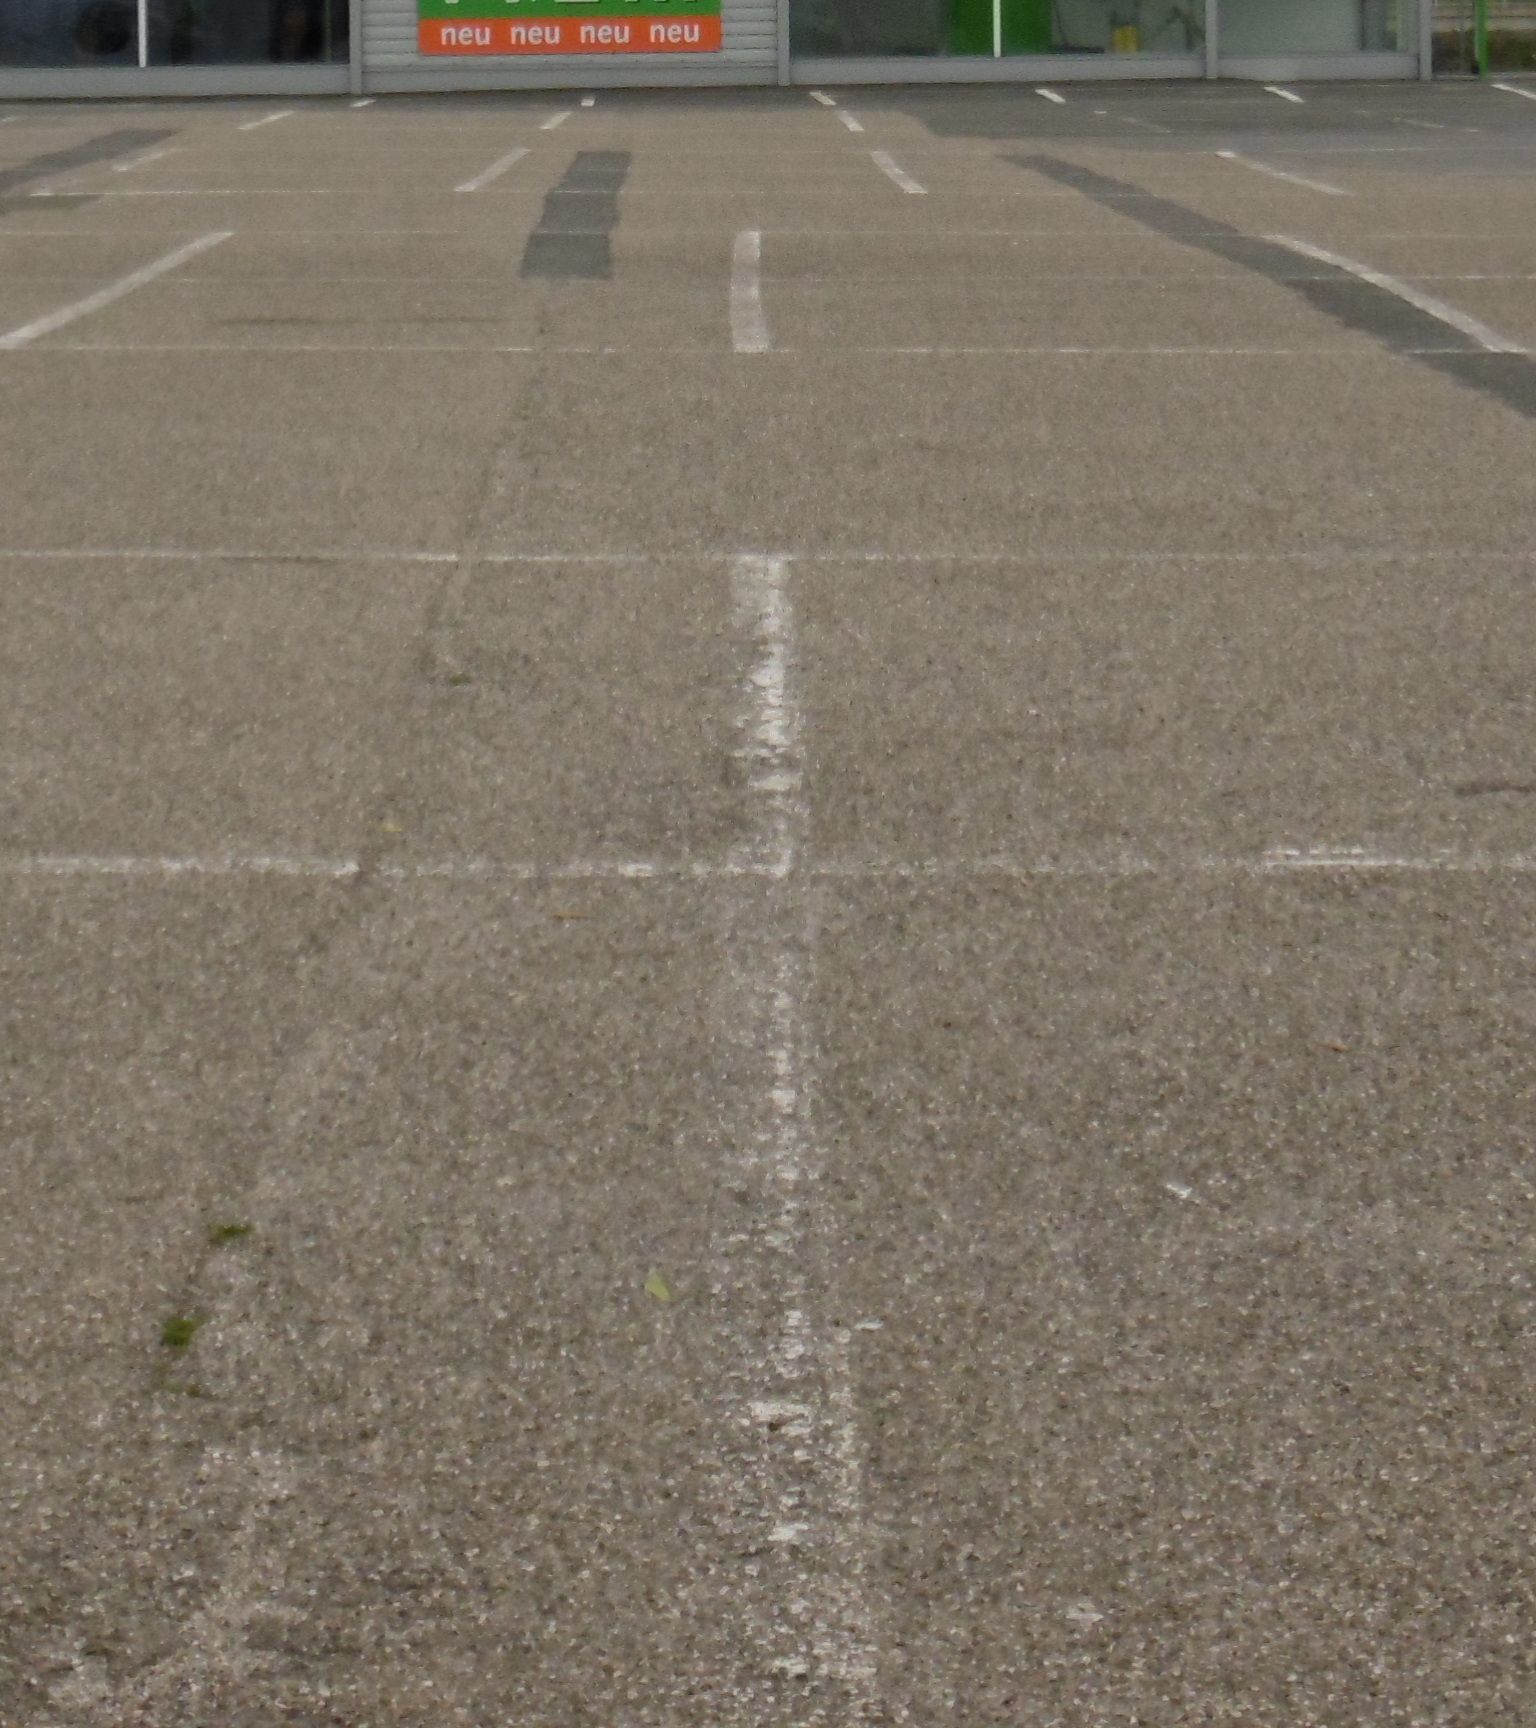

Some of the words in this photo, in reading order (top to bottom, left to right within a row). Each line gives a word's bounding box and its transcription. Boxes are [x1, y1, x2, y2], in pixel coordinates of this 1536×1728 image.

[440, 26, 492, 46] neu
[510, 25, 561, 45] neu
[580, 24, 631, 44] neu
[649, 22, 701, 43] neu
